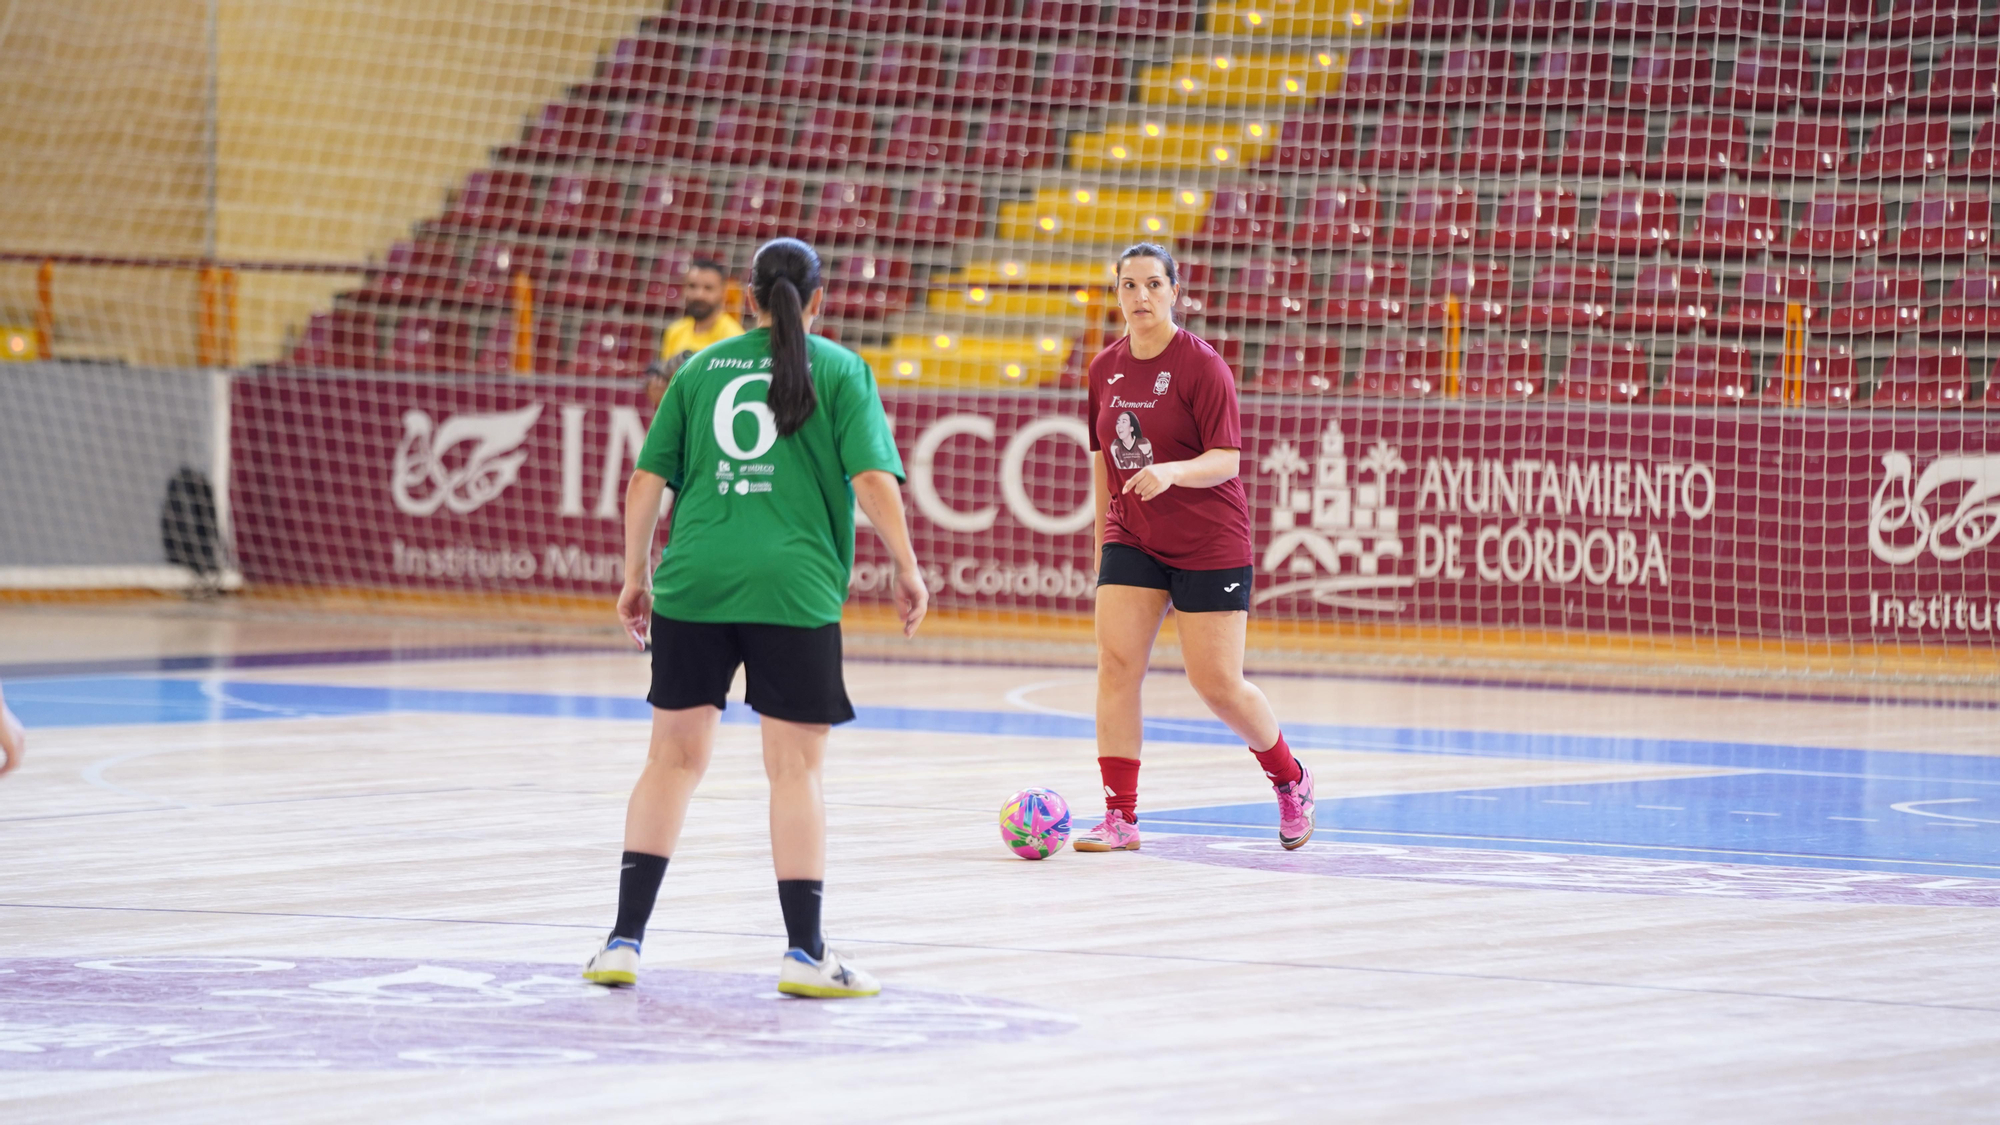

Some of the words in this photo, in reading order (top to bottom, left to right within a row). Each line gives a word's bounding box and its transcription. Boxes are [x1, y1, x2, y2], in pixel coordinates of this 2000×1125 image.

[706, 357, 754, 371] Inma
[713, 372, 779, 461] 6
[1115, 399, 1158, 409] Memorial
[557, 404, 1096, 536] IMCO
[1420, 455, 1716, 520] AYUNTAMIENTO
[393, 541, 538, 580] Instituto
[1418, 522, 1466, 580] DE
[1475, 517, 1669, 586] CÓRDOBA
